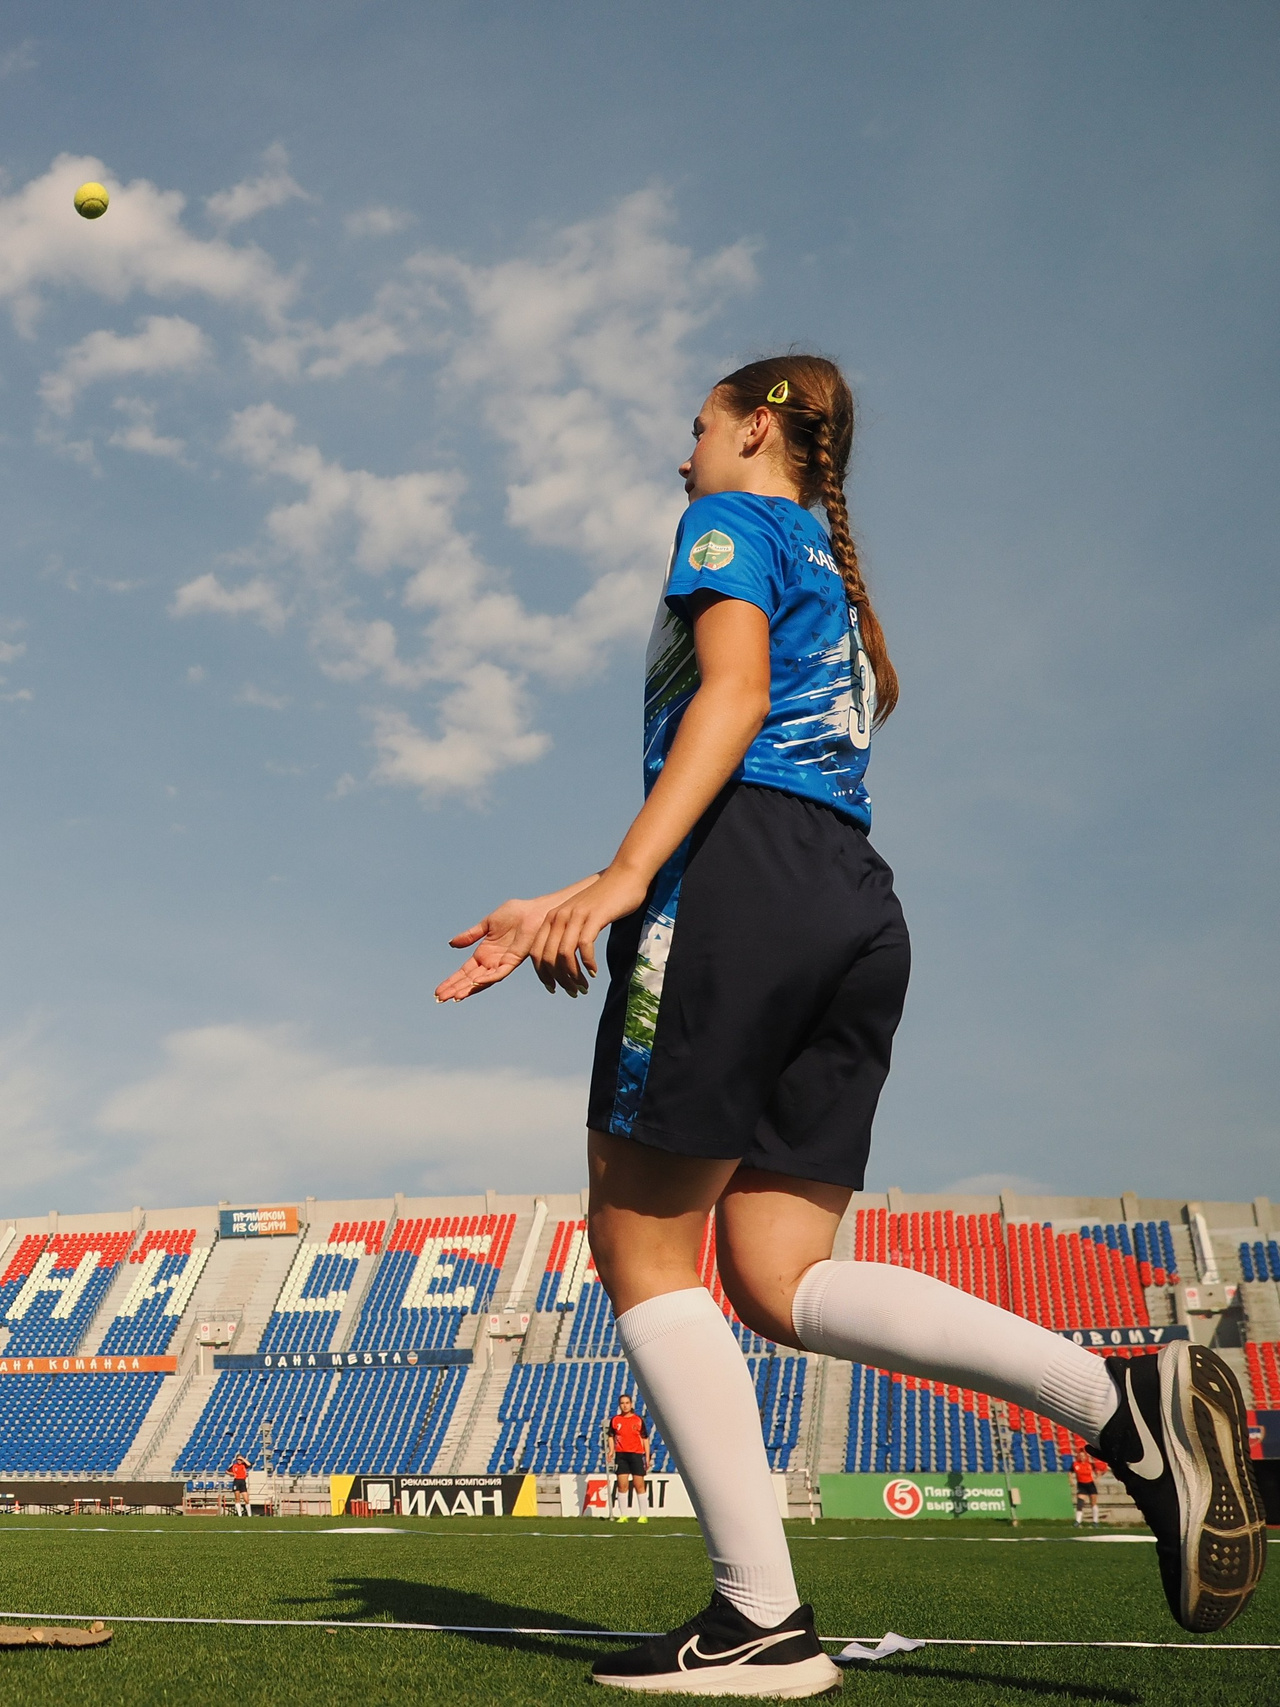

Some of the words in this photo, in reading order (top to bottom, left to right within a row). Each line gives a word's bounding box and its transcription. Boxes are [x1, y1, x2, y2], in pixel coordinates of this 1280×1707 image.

[232, 1211, 286, 1222] ПРЯМИКОМ
[232, 1223, 246, 1233] ИЗ
[247, 1221, 287, 1232] СИБИРИ
[1059, 1328, 1165, 1345] ОВОМУ
[49, 1358, 140, 1371] КОМАНДА
[265, 1356, 316, 1368] ОДНА
[400, 1478, 453, 1487] рекламная
[454, 1477, 502, 1486] компания
[924, 1485, 1004, 1499] Пятёрочка
[400, 1490, 503, 1516] ИЛАН
[926, 1500, 1006, 1513] выручает!
